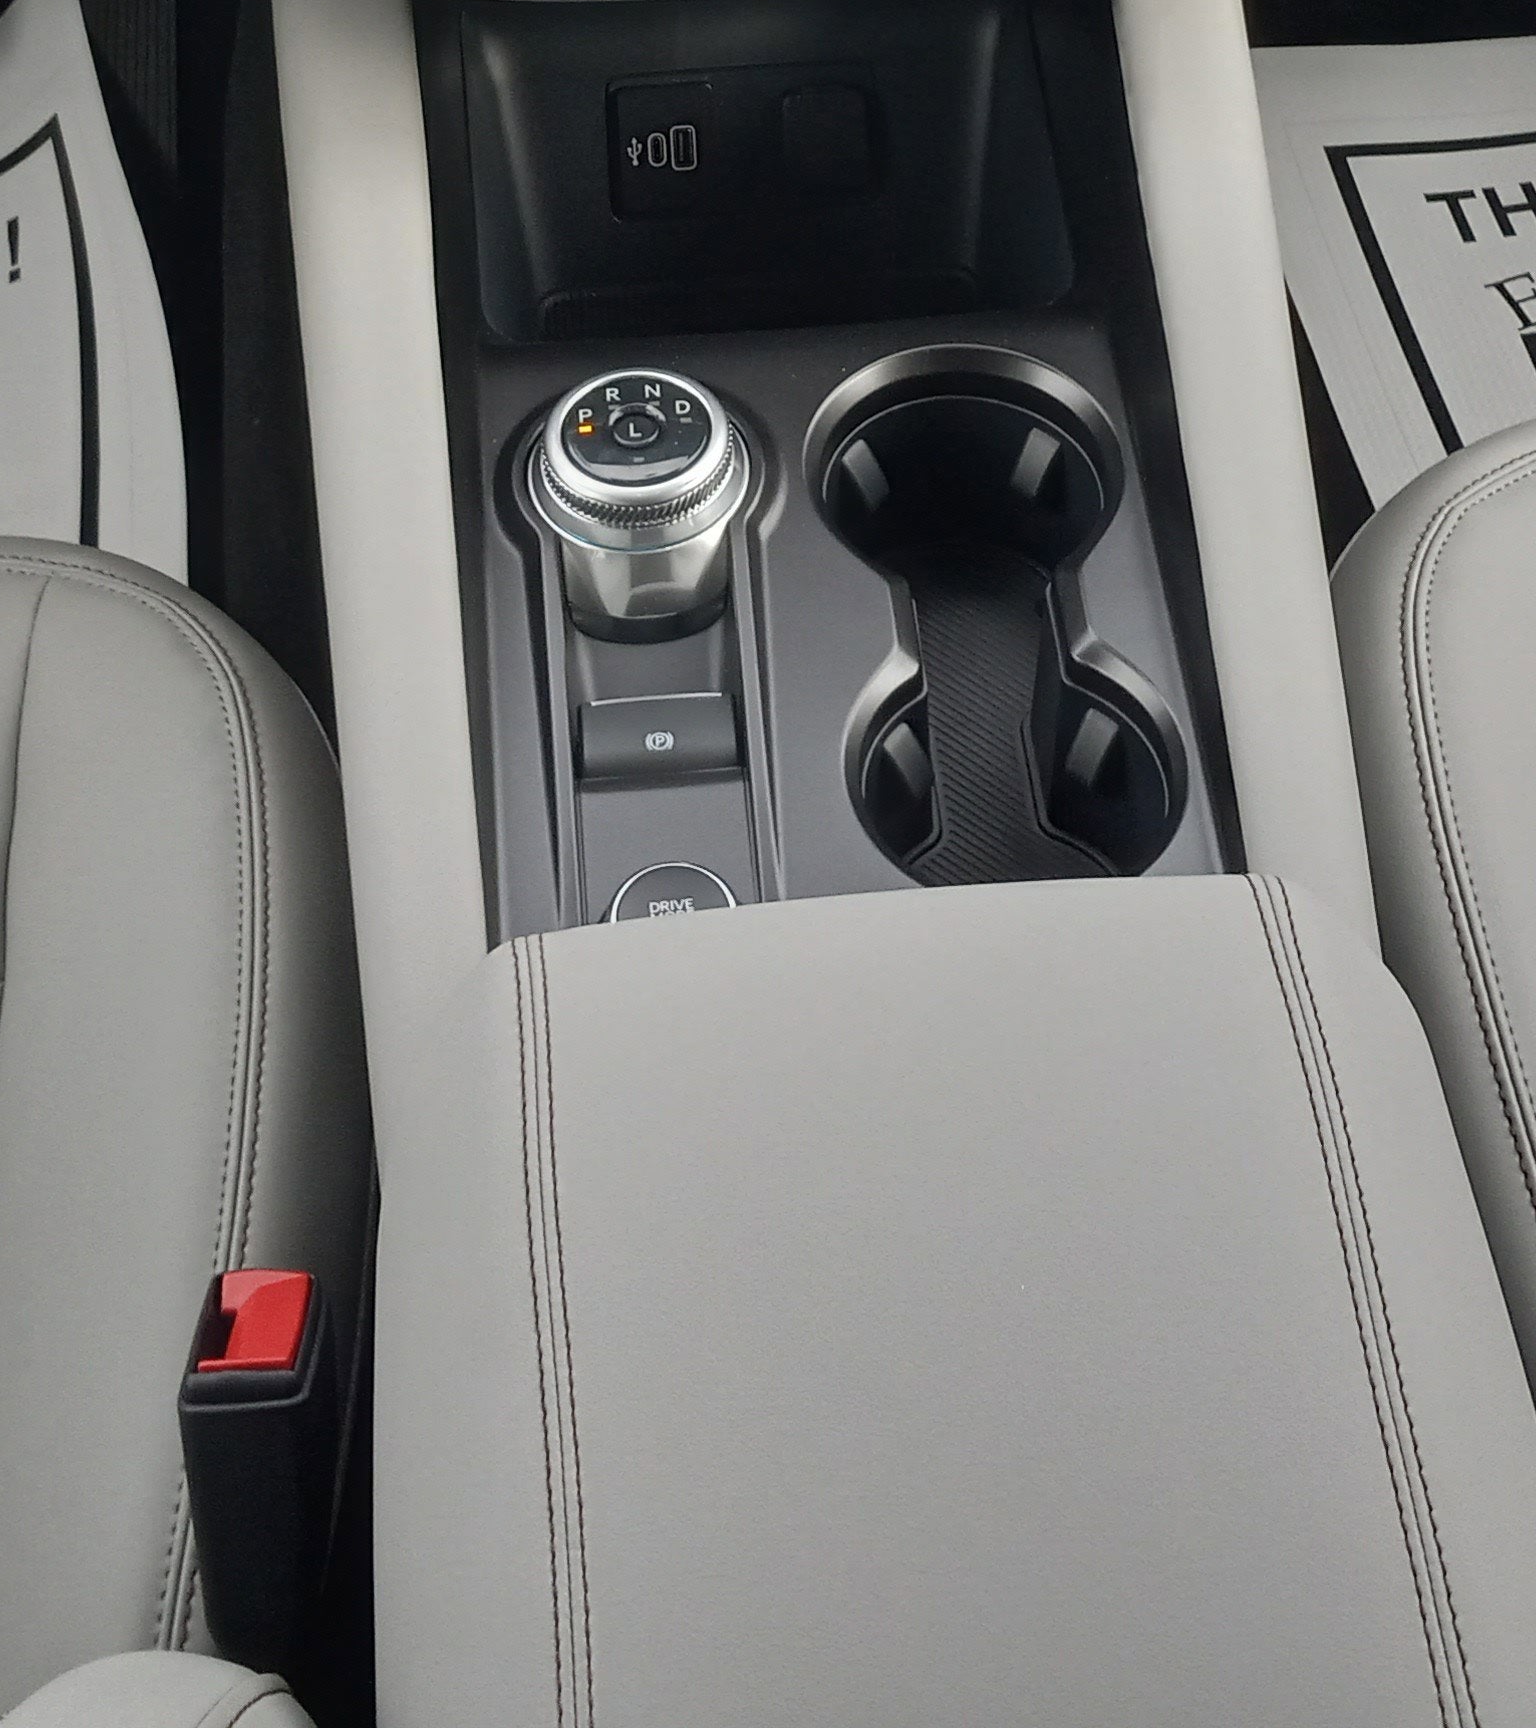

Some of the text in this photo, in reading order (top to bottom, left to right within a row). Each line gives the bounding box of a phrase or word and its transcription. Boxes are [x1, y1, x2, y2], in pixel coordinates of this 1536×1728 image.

[605, 387, 621, 402] R
[644, 383, 662, 399] N
[675, 400, 691, 415] D
[578, 408, 593, 423] P
[628, 422, 642, 438] L
[648, 897, 694, 913] DRIVE
